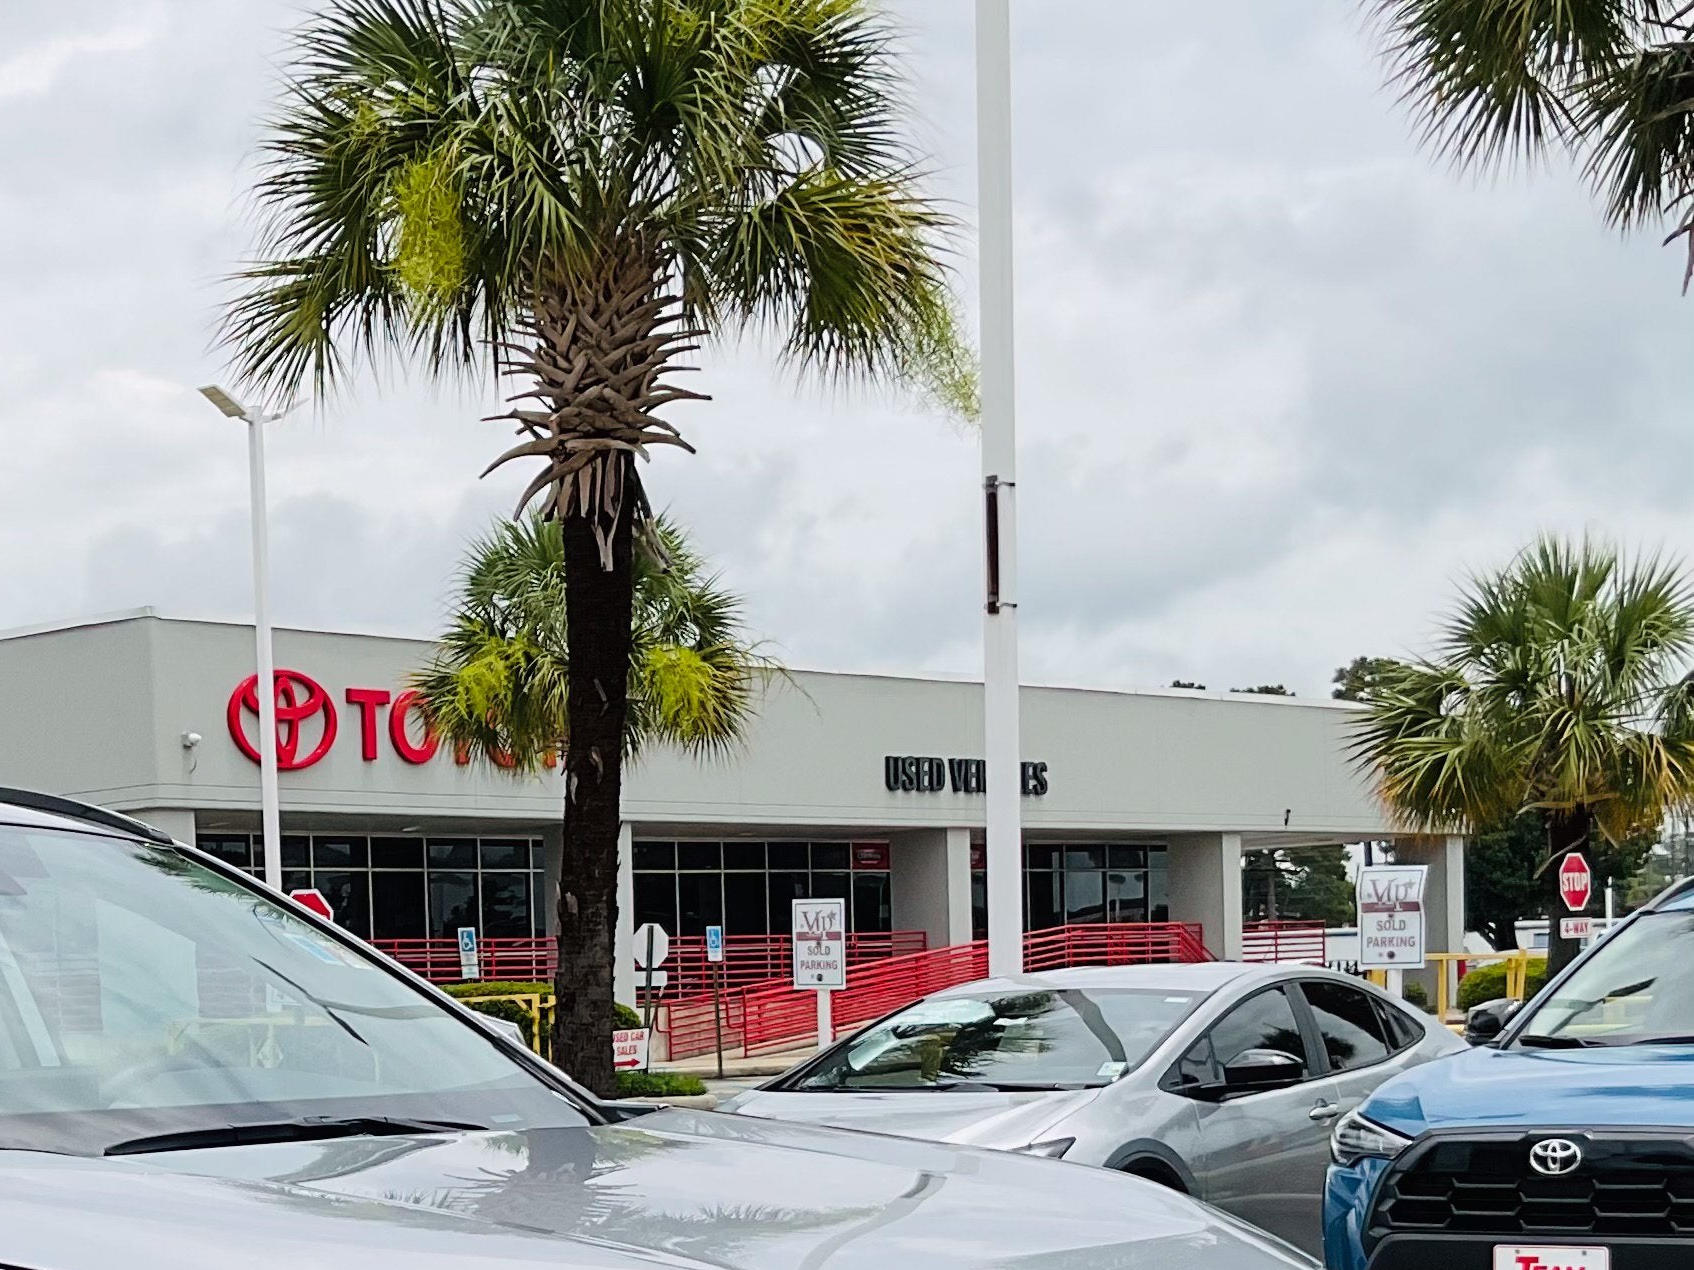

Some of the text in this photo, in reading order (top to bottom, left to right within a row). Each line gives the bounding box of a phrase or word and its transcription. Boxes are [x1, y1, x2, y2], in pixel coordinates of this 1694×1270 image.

[885, 756, 1048, 795] USED VEES
[1563, 872, 1588, 891] STOP
[1376, 920, 1406, 931] SOLD
[1564, 922, 1589, 934] 4-WAY
[1366, 936, 1416, 948] PARKING
[807, 946, 831, 956] SOLD
[800, 960, 838, 970] PARKING
[631, 1031, 644, 1041] CAR
[617, 1045, 637, 1056] SALES
